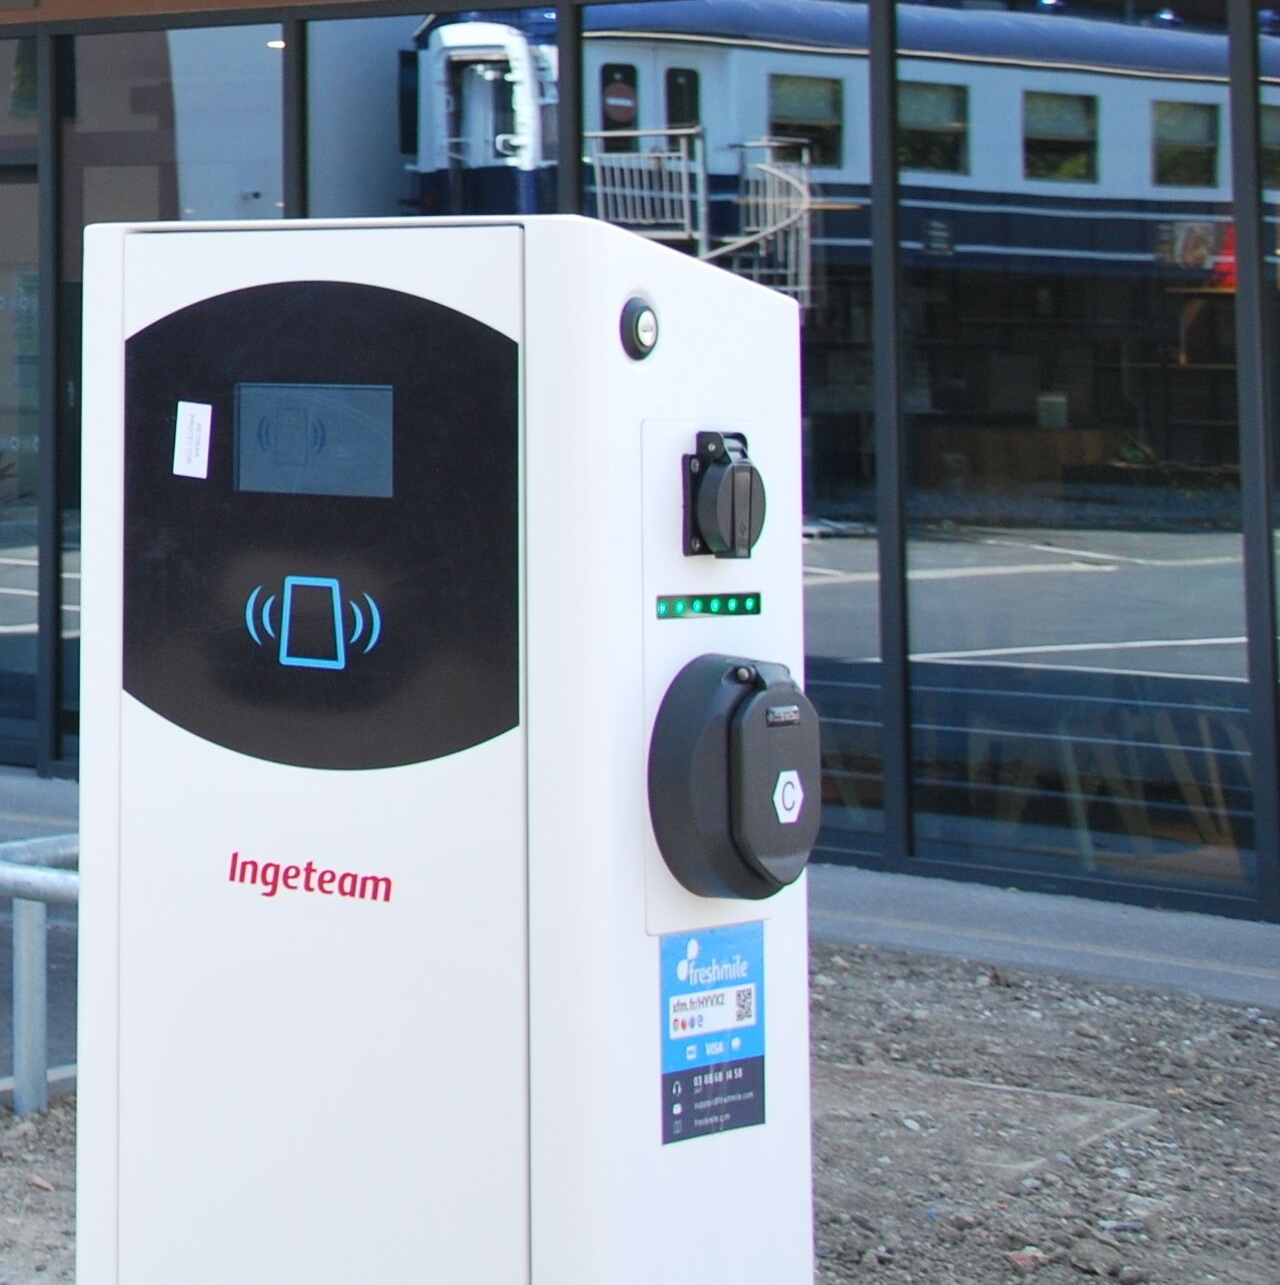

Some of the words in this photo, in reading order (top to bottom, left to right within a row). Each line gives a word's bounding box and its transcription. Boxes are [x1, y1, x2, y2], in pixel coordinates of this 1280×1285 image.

[782, 781, 795, 811] C
[229, 851, 392, 902] Ingeteam
[689, 955, 748, 986] freshmile
